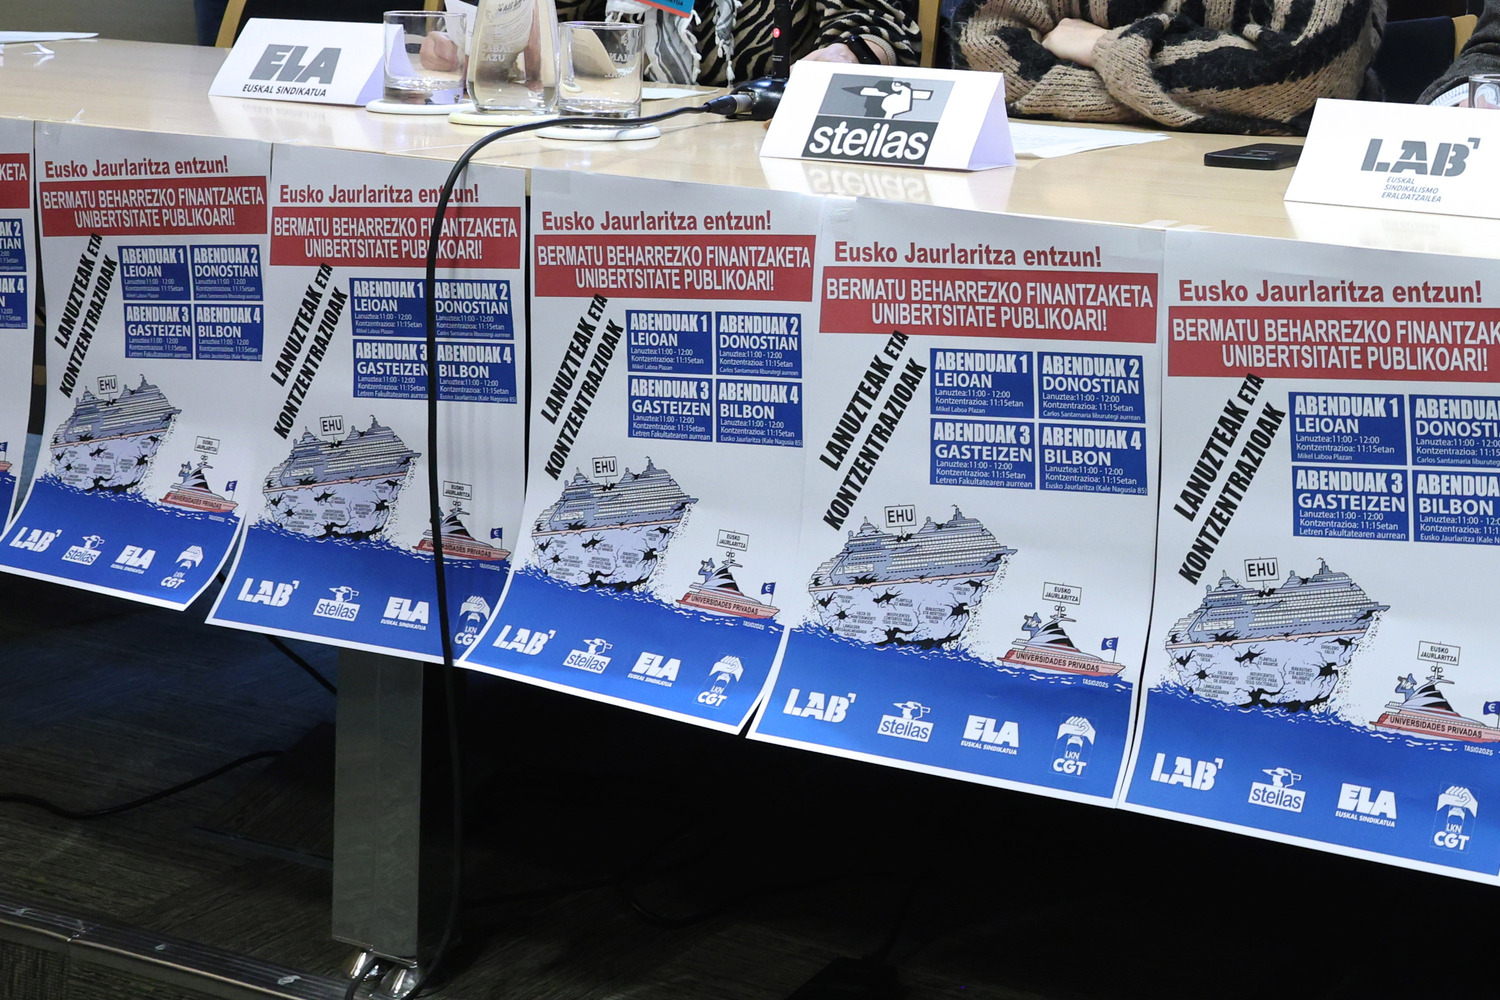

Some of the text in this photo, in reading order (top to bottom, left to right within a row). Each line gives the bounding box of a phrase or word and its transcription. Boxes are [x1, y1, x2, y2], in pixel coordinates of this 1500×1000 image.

[249, 44, 342, 84] ELA
[242, 84, 327, 97] EUSKAL SINDIKATUA
[809, 121, 928, 160] steilas
[1361, 137, 1480, 177] LAB
[45, 160, 88, 178] Eusko
[92, 157, 170, 176] Jaurlaritza
[174, 156, 228, 174] entzun!
[1384, 184, 1439, 194] SINDIKALISMO
[1386, 176, 1415, 184] EUSKAL
[1381, 192, 1442, 202] ERALDATZAILEA
[273, 218, 330, 236] BERMATU
[333, 218, 417, 237] BEHARREZKO
[543, 211, 770, 230] Eusko Jaurlaritza entzun!
[835, 241, 1101, 267] Eusko Jaurlaritza entzun!
[1179, 280, 1481, 303] Eusko Jaurlaritza entzun!
[1173, 319, 1258, 341] BERMATU
[1264, 319, 1391, 343] BEHARREZKO
[1222, 345, 1488, 371] UNIBERTSITATE PUBLIKOARI!
[1295, 396, 1398, 417] ABENDUAK 1
[1296, 417, 1358, 433] LEIOAN
[1173, 373, 1265, 522] LANUZTEAK ETA
[1296, 443, 1394, 453] Kontzentrazioa: 11:15etan
[1416, 447, 1477, 456] Kontzentrazioa:
[1437, 457, 1470, 465] Santamaria
[1296, 470, 1403, 493] ABENDUAK 3
[1178, 401, 1286, 585] KONTZENTRAZIOAK
[1298, 493, 1405, 512] GASTEIZEN
[1419, 498, 1493, 516] BILBON
[1300, 520, 1398, 530] Kontzentrazioa: 11:15etan
[1325, 529, 1375, 538] Fakultatearen
[1420, 524, 1481, 533] Kontzentrazioa:
[1441, 534, 1474, 542] Jaurlaritza
[1477, 536, 1493, 544] (Kale
[1248, 562, 1276, 577] EHU
[1420, 652, 1456, 662] JAURLARITZA
[1430, 646, 1448, 654] EUSKO
[1390, 716, 1482, 738] UNIVERSIDADES PRIVADAS
[1150, 752, 1224, 791] LAB
[1252, 787, 1301, 809] steilas
[1337, 783, 1397, 819] ELA
[1335, 810, 1395, 828] EUSKAL SINDIKATUA
[1446, 823, 1462, 833] LKN
[1434, 830, 1470, 850] CGT
